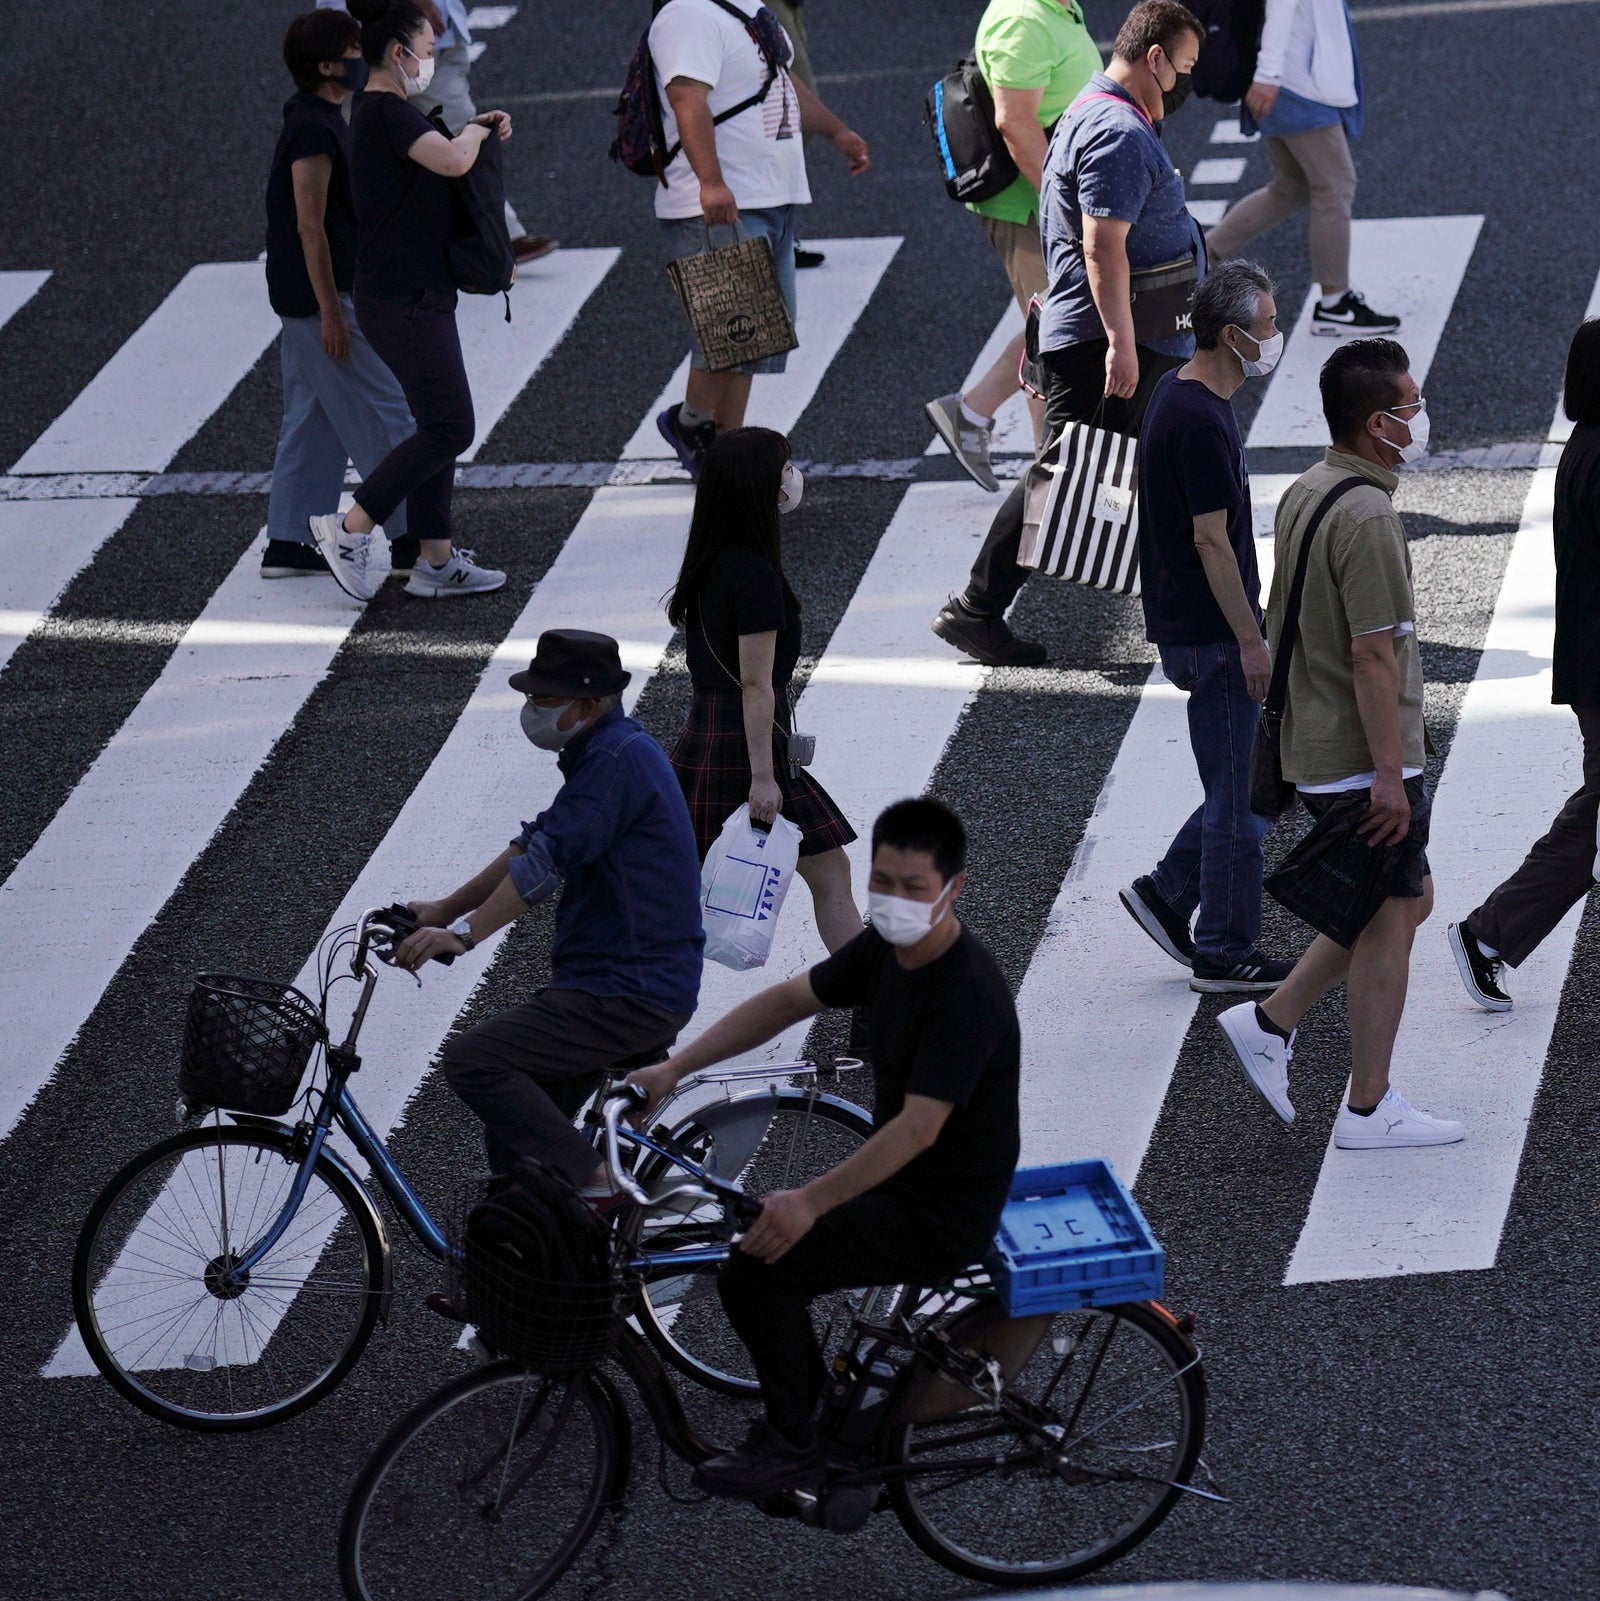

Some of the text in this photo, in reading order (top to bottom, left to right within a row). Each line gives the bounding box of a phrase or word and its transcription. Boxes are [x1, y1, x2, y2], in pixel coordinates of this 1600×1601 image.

[714, 315, 765, 337] Hard Rock
[758, 867, 781, 921] PLAZA
